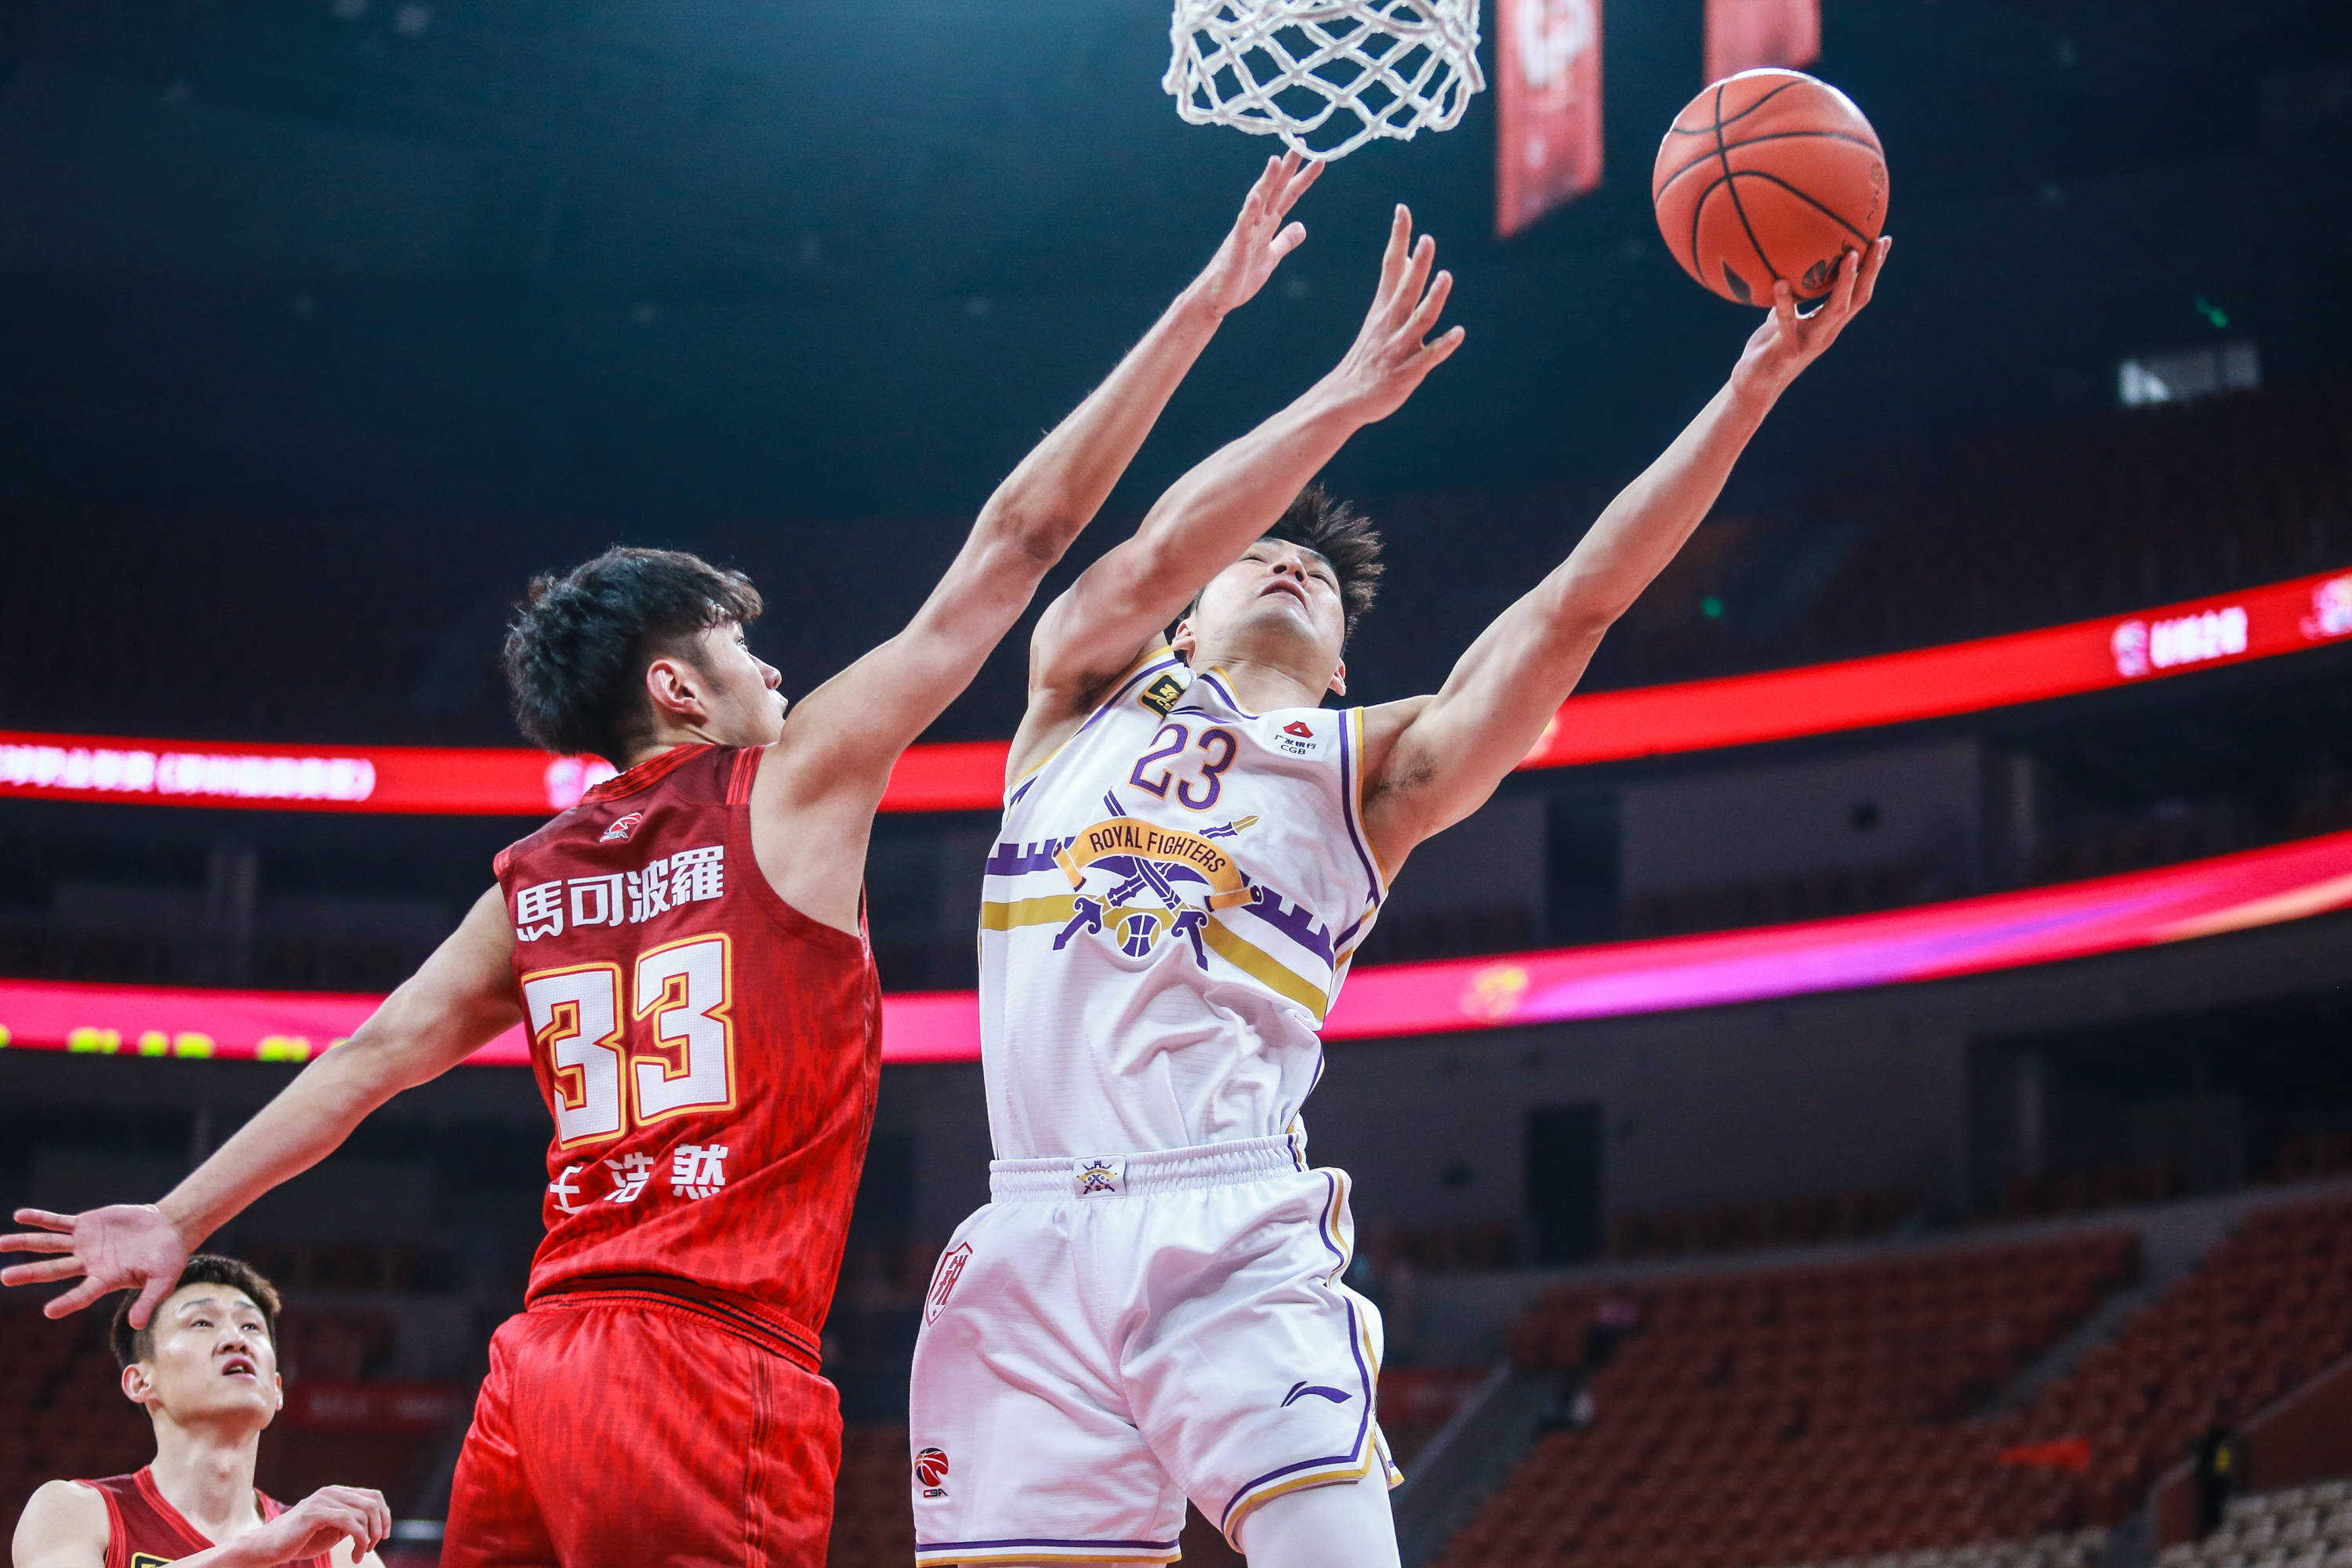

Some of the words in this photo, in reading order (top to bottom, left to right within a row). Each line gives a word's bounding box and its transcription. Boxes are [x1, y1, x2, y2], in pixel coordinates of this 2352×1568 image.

[1127, 722, 1239, 813] 23
[1274, 735, 1316, 750] 广发银行
[1280, 744, 1305, 755] CGB
[1089, 826, 1142, 853] ROYAL
[1147, 831, 1225, 873] FIGHTERS
[517, 845, 724, 942] 馬可波羅
[521, 933, 737, 1151] 33
